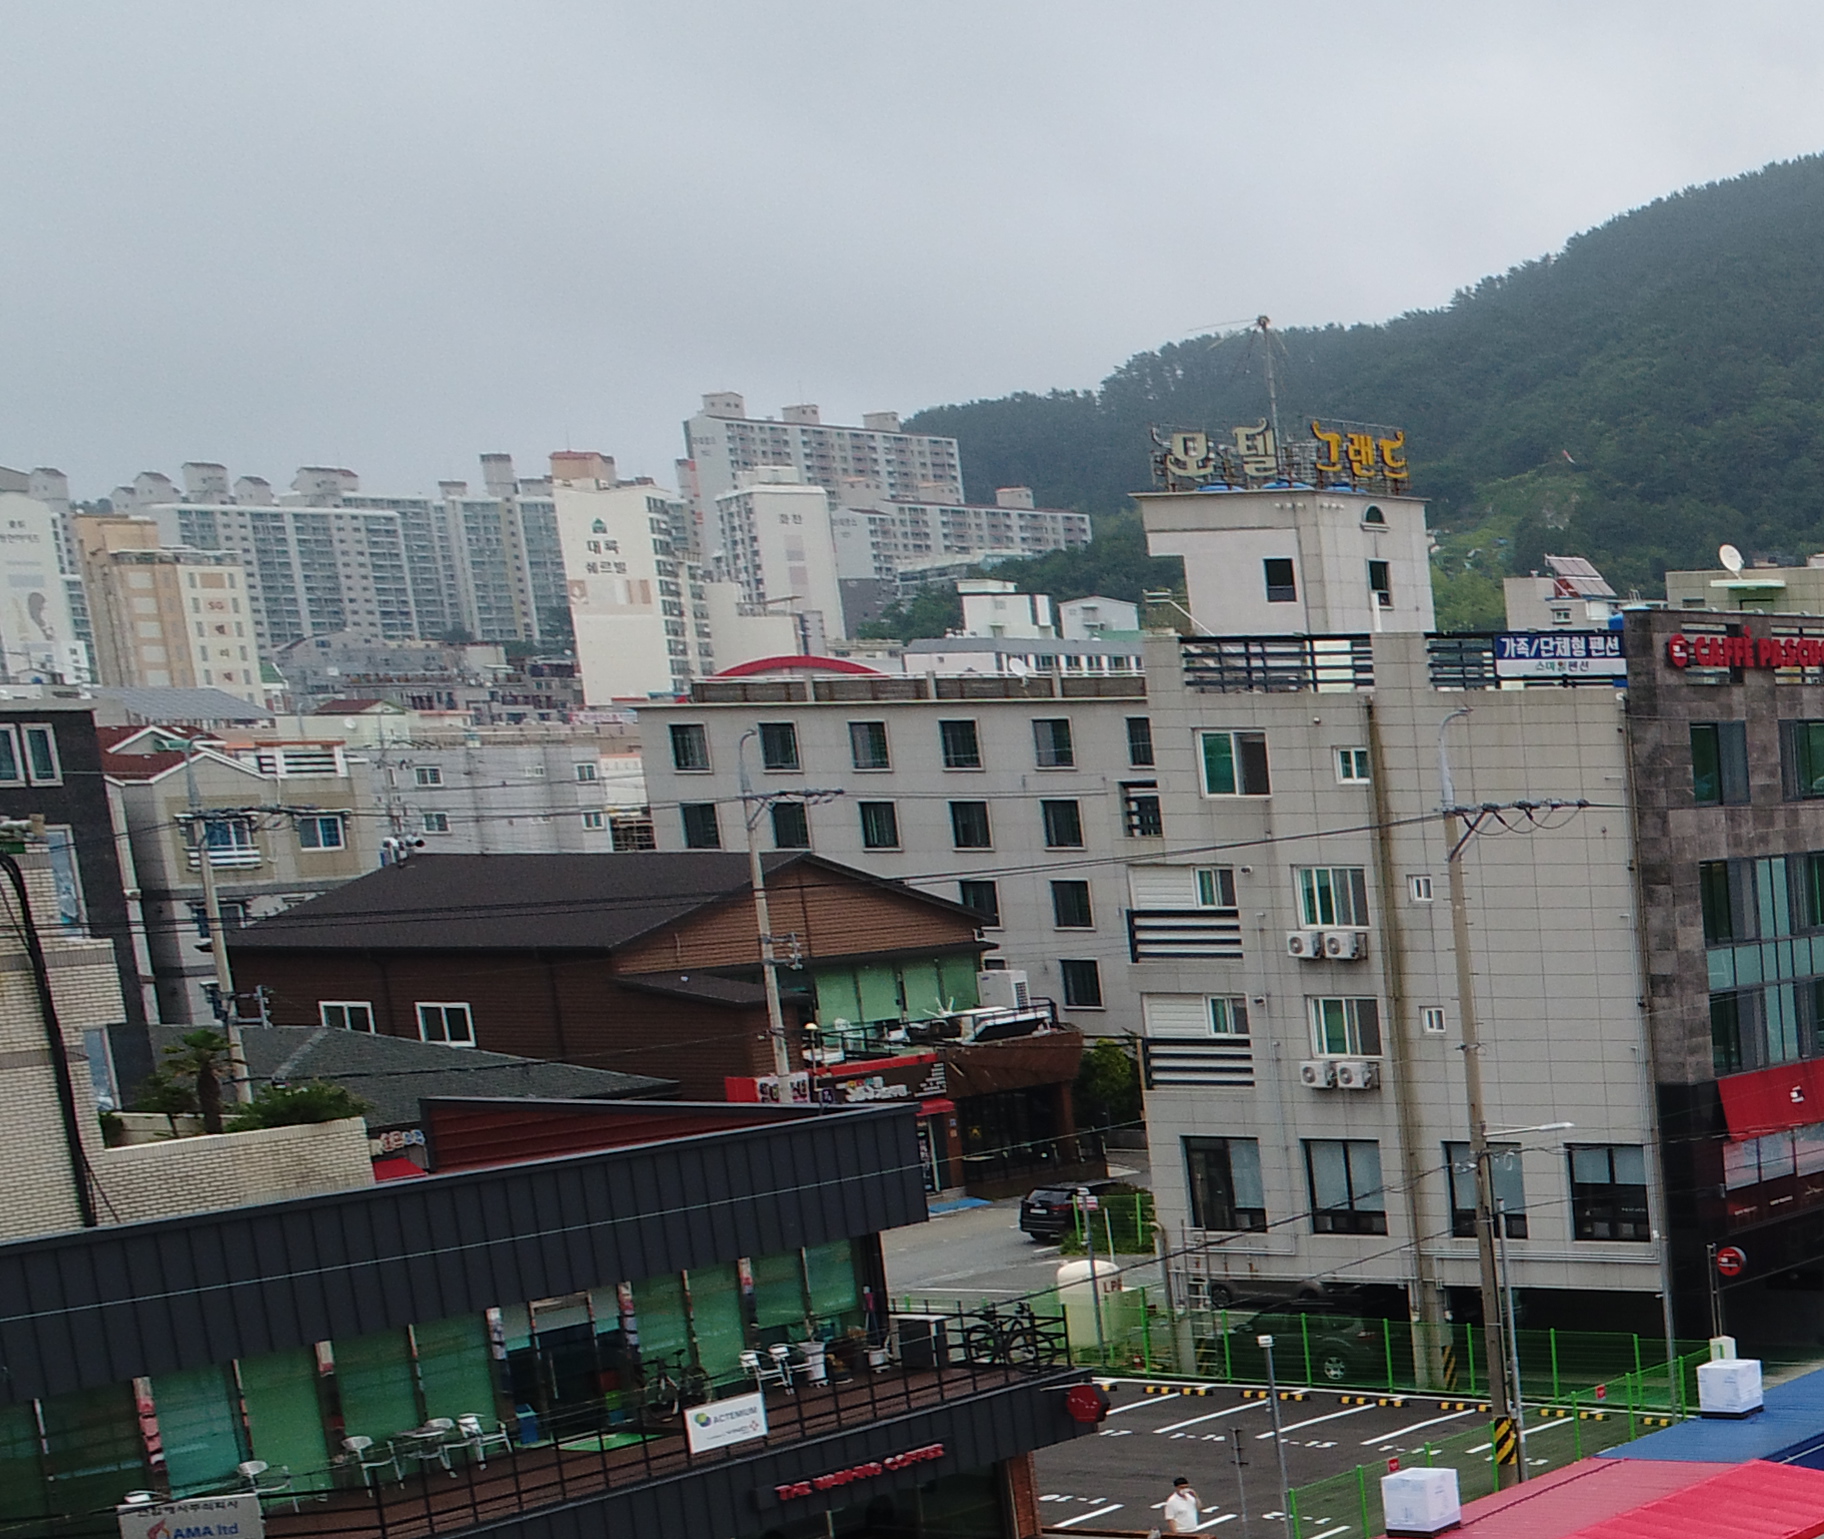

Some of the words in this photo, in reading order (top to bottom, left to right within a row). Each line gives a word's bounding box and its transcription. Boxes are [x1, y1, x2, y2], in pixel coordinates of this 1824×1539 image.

[1166, 417, 1277, 477] 모텔
[1311, 420, 1408, 478] 그랜드
[1500, 636, 1586, 658] 가족/단체형
[1589, 636, 1620, 657] 펜션
[217, 1523, 239, 1536] ltd
